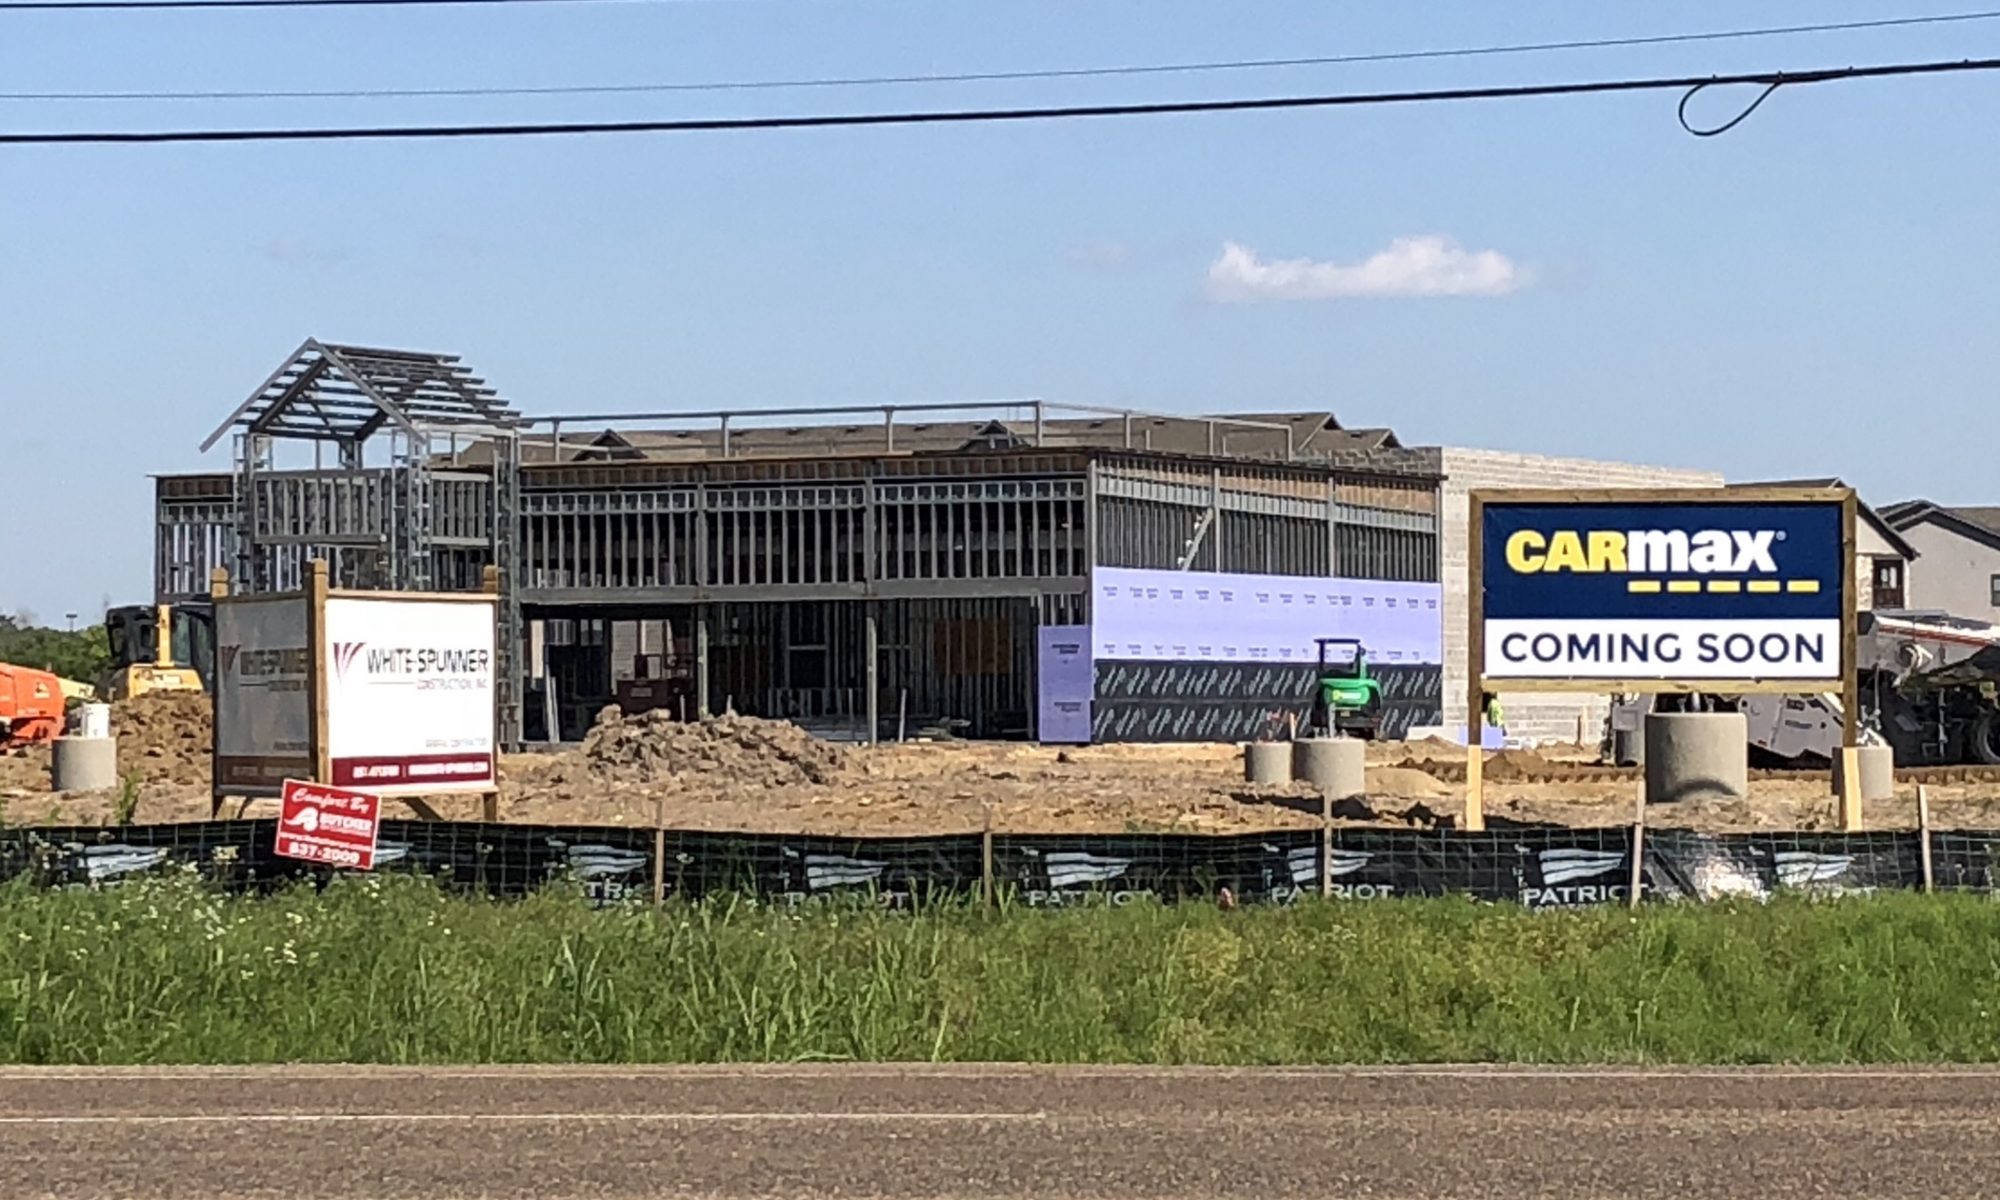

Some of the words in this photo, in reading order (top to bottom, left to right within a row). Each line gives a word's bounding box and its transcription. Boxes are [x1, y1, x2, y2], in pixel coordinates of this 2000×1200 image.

[1500, 632, 1682, 663] COMING
[1698, 632, 1824, 663] SOON
[350, 797, 370, 814] By
[1271, 883, 1395, 904] PARIOT
[1523, 884, 1649, 906] PATRIO
